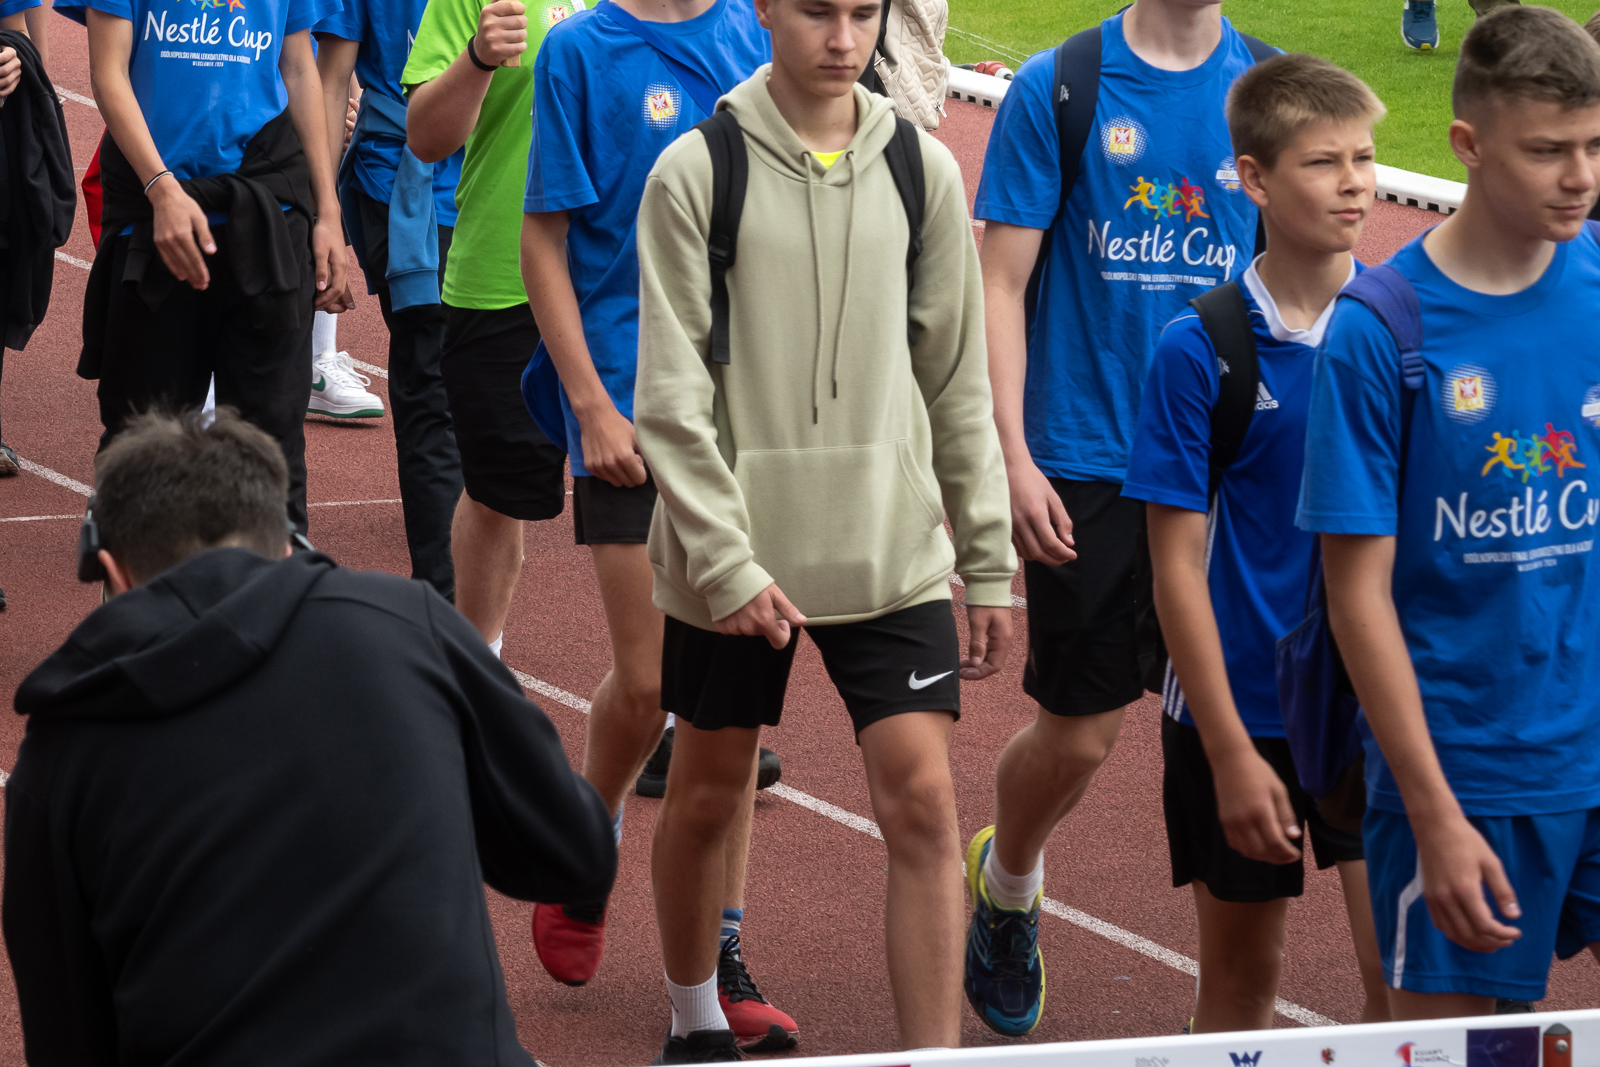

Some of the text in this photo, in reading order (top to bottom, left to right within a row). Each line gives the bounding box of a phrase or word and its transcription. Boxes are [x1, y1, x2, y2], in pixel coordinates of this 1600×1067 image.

[144, 10, 273, 61] Nestlé Cup
[1088, 219, 1236, 282] Nestlé Cup
[1433, 485, 1552, 542] Nestlé
